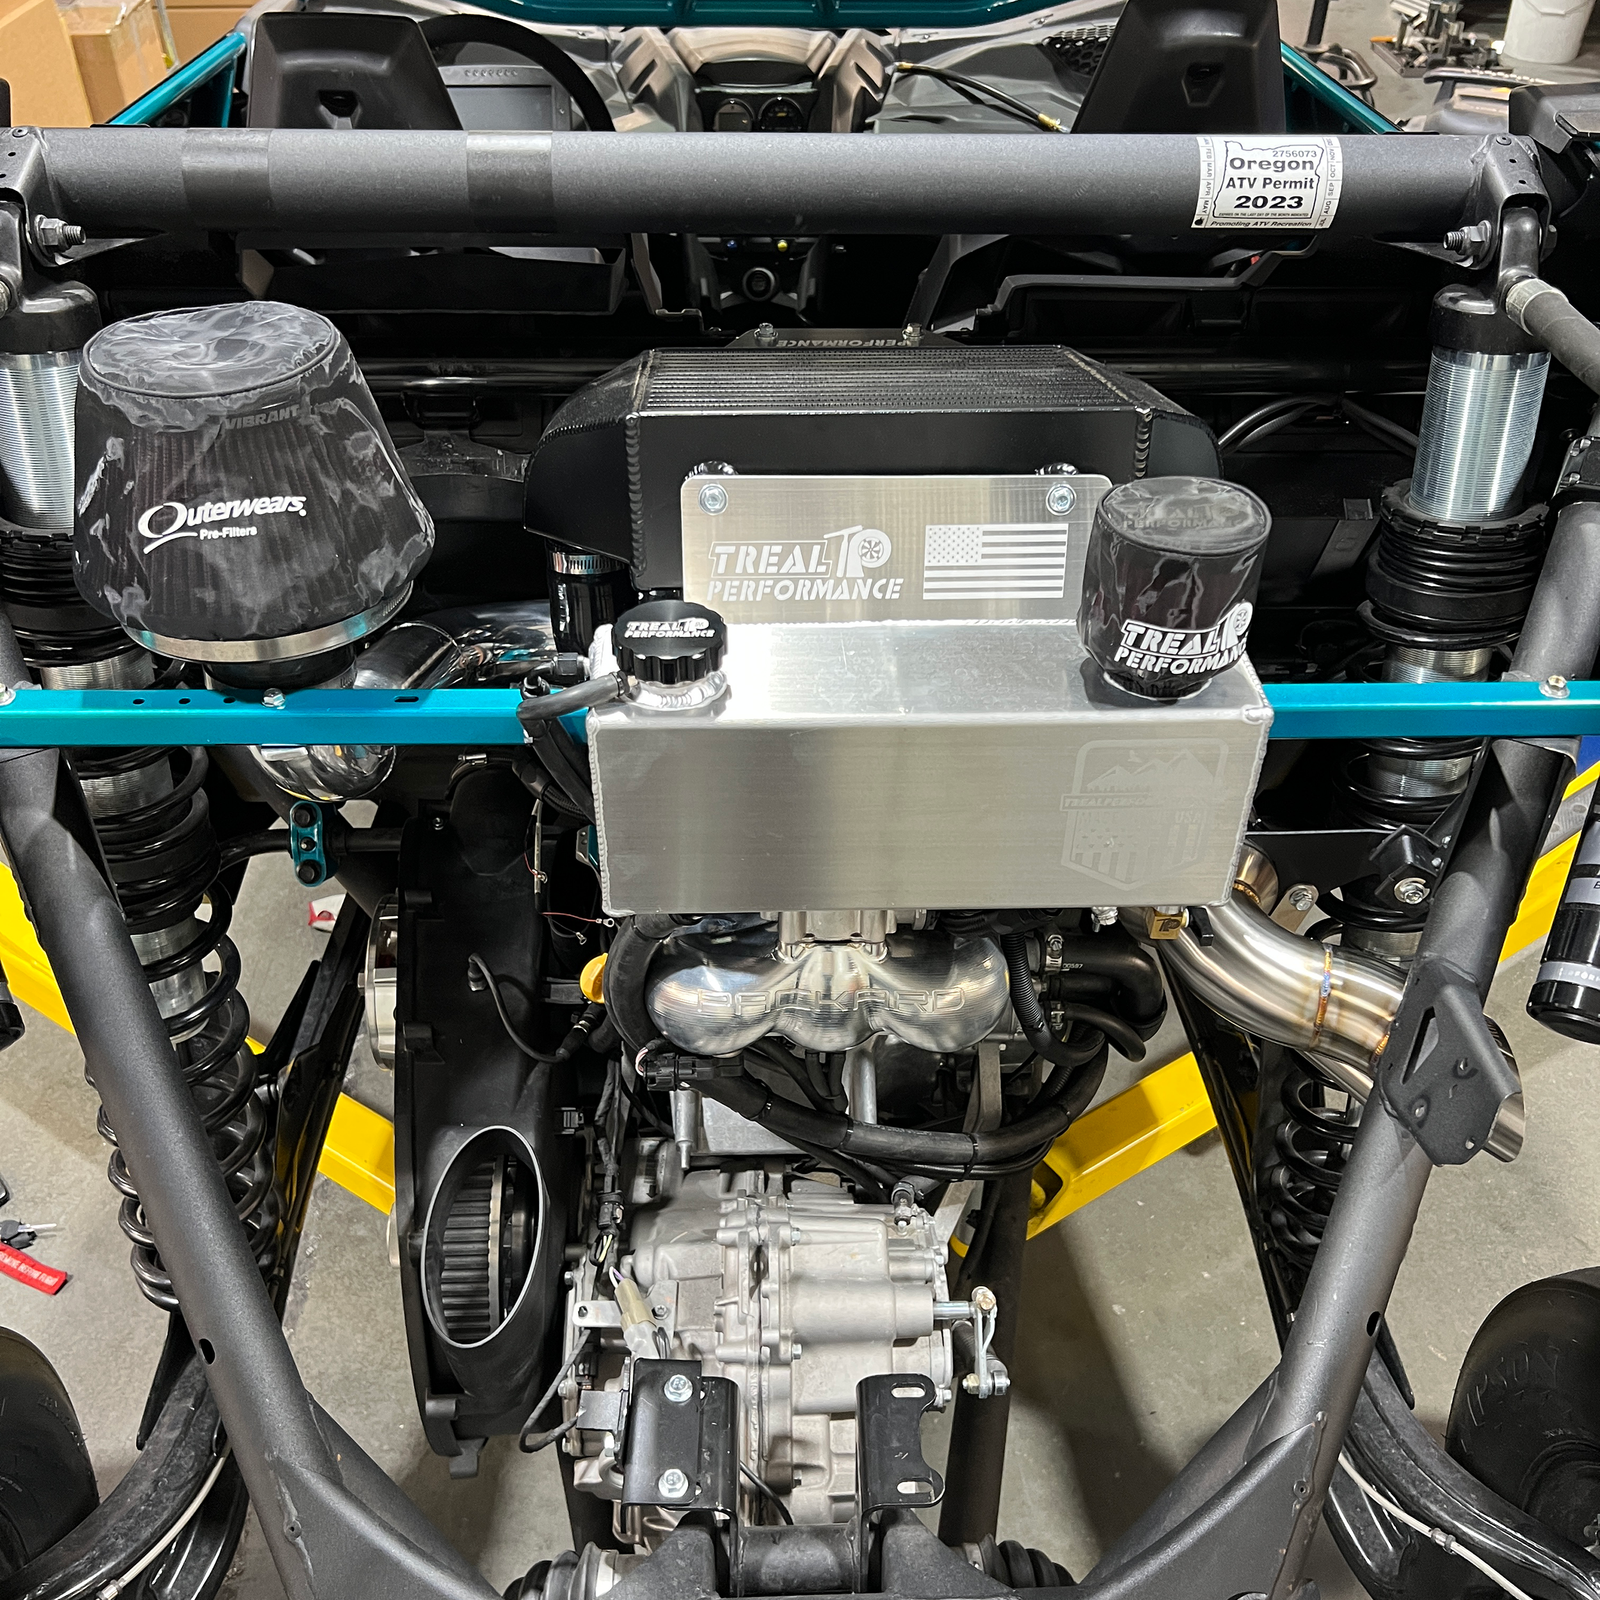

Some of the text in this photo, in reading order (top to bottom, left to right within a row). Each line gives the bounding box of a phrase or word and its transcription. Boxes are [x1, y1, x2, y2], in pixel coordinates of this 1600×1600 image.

[1272, 150, 1317, 158] 2756073
[1229, 157, 1314, 172] Oregon
[1226, 177, 1315, 189] ATV Permit
[1327, 182, 1335, 196] SEP
[1201, 200, 1209, 214] MAY
[1234, 195, 1304, 209] 2023
[1323, 200, 1332, 214] AUG
[223, 404, 299, 430] VIBRANT
[200, 526, 258, 540] Pre-Filters
[714, 544, 828, 574] TREAL
[707, 578, 904, 601] PERFORMANCE
[626, 621, 681, 631] TREAL
[624, 629, 715, 638] PERFORMANCE
[1125, 624, 1219, 656] TREAL
[697, 987, 966, 1016] PACKARD
